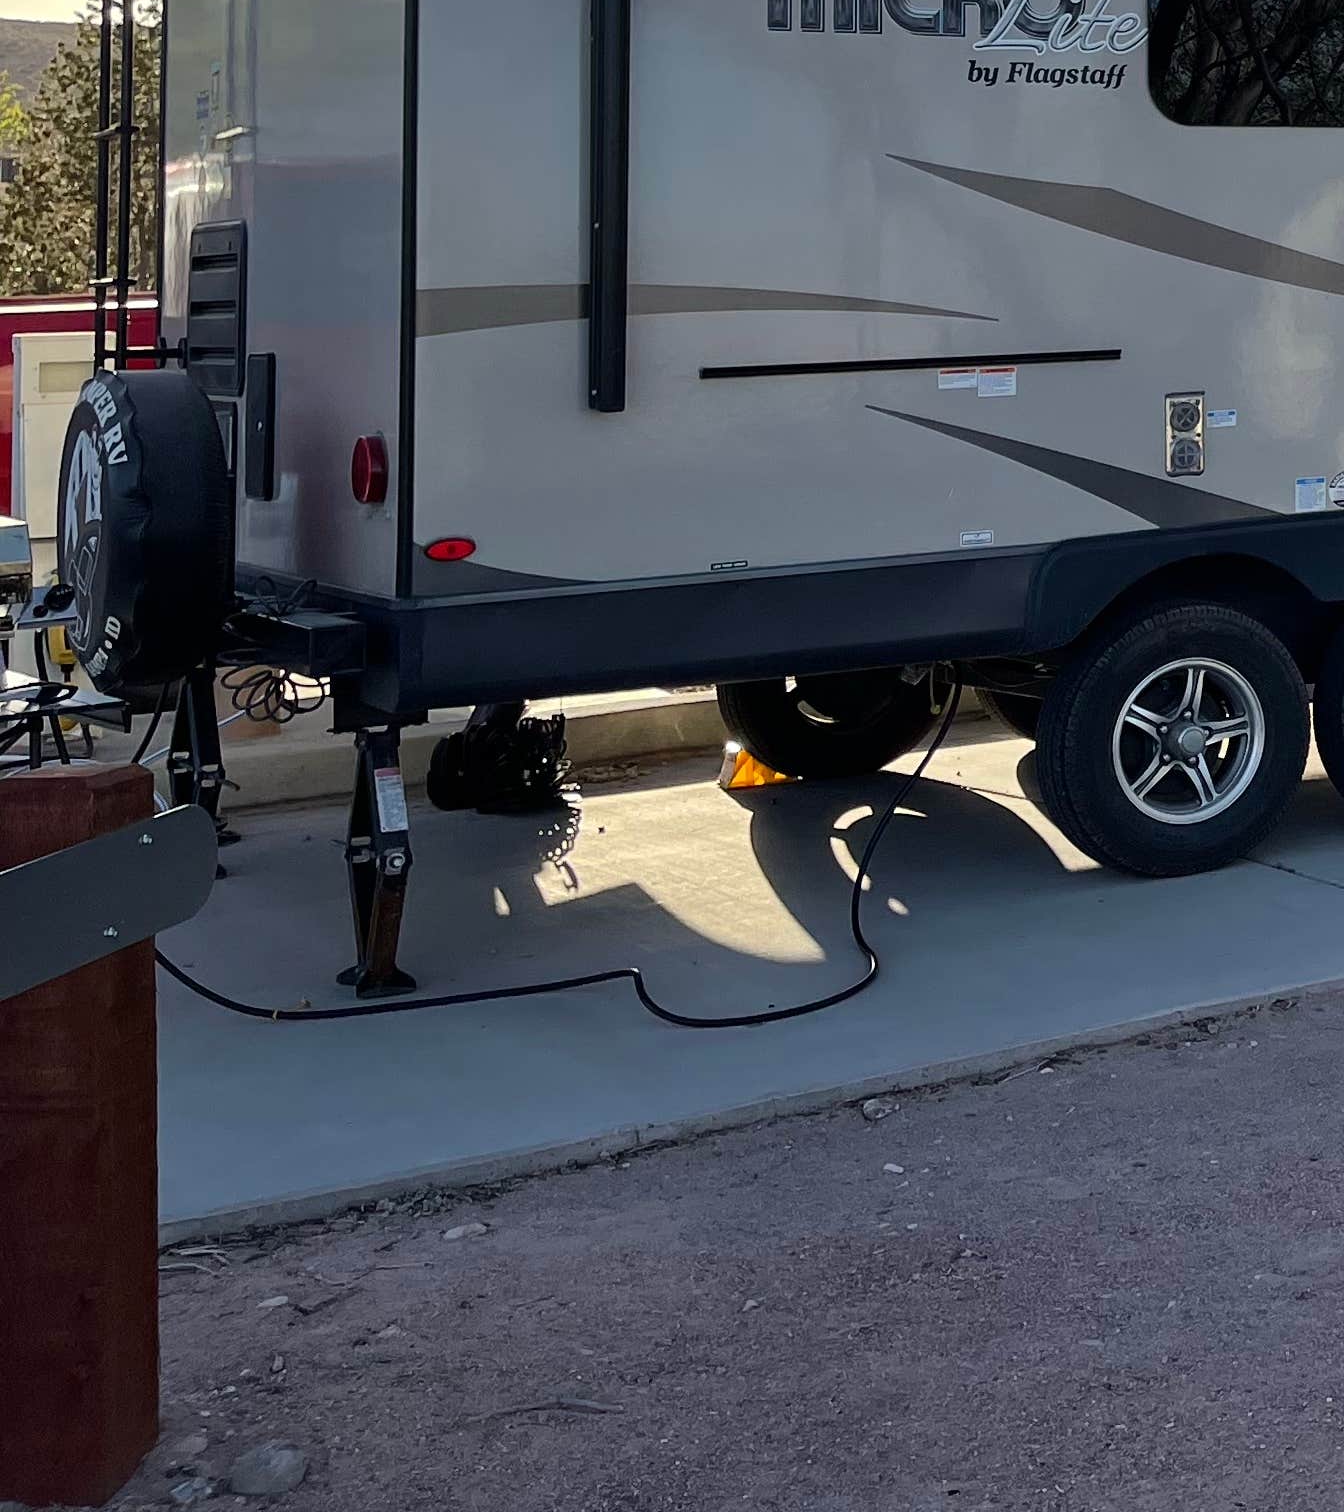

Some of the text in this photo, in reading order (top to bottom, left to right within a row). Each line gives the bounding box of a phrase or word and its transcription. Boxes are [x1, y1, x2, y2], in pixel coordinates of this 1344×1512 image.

[967, 59, 1127, 89] by Flagstaff
[103, 422, 128, 465] RV
